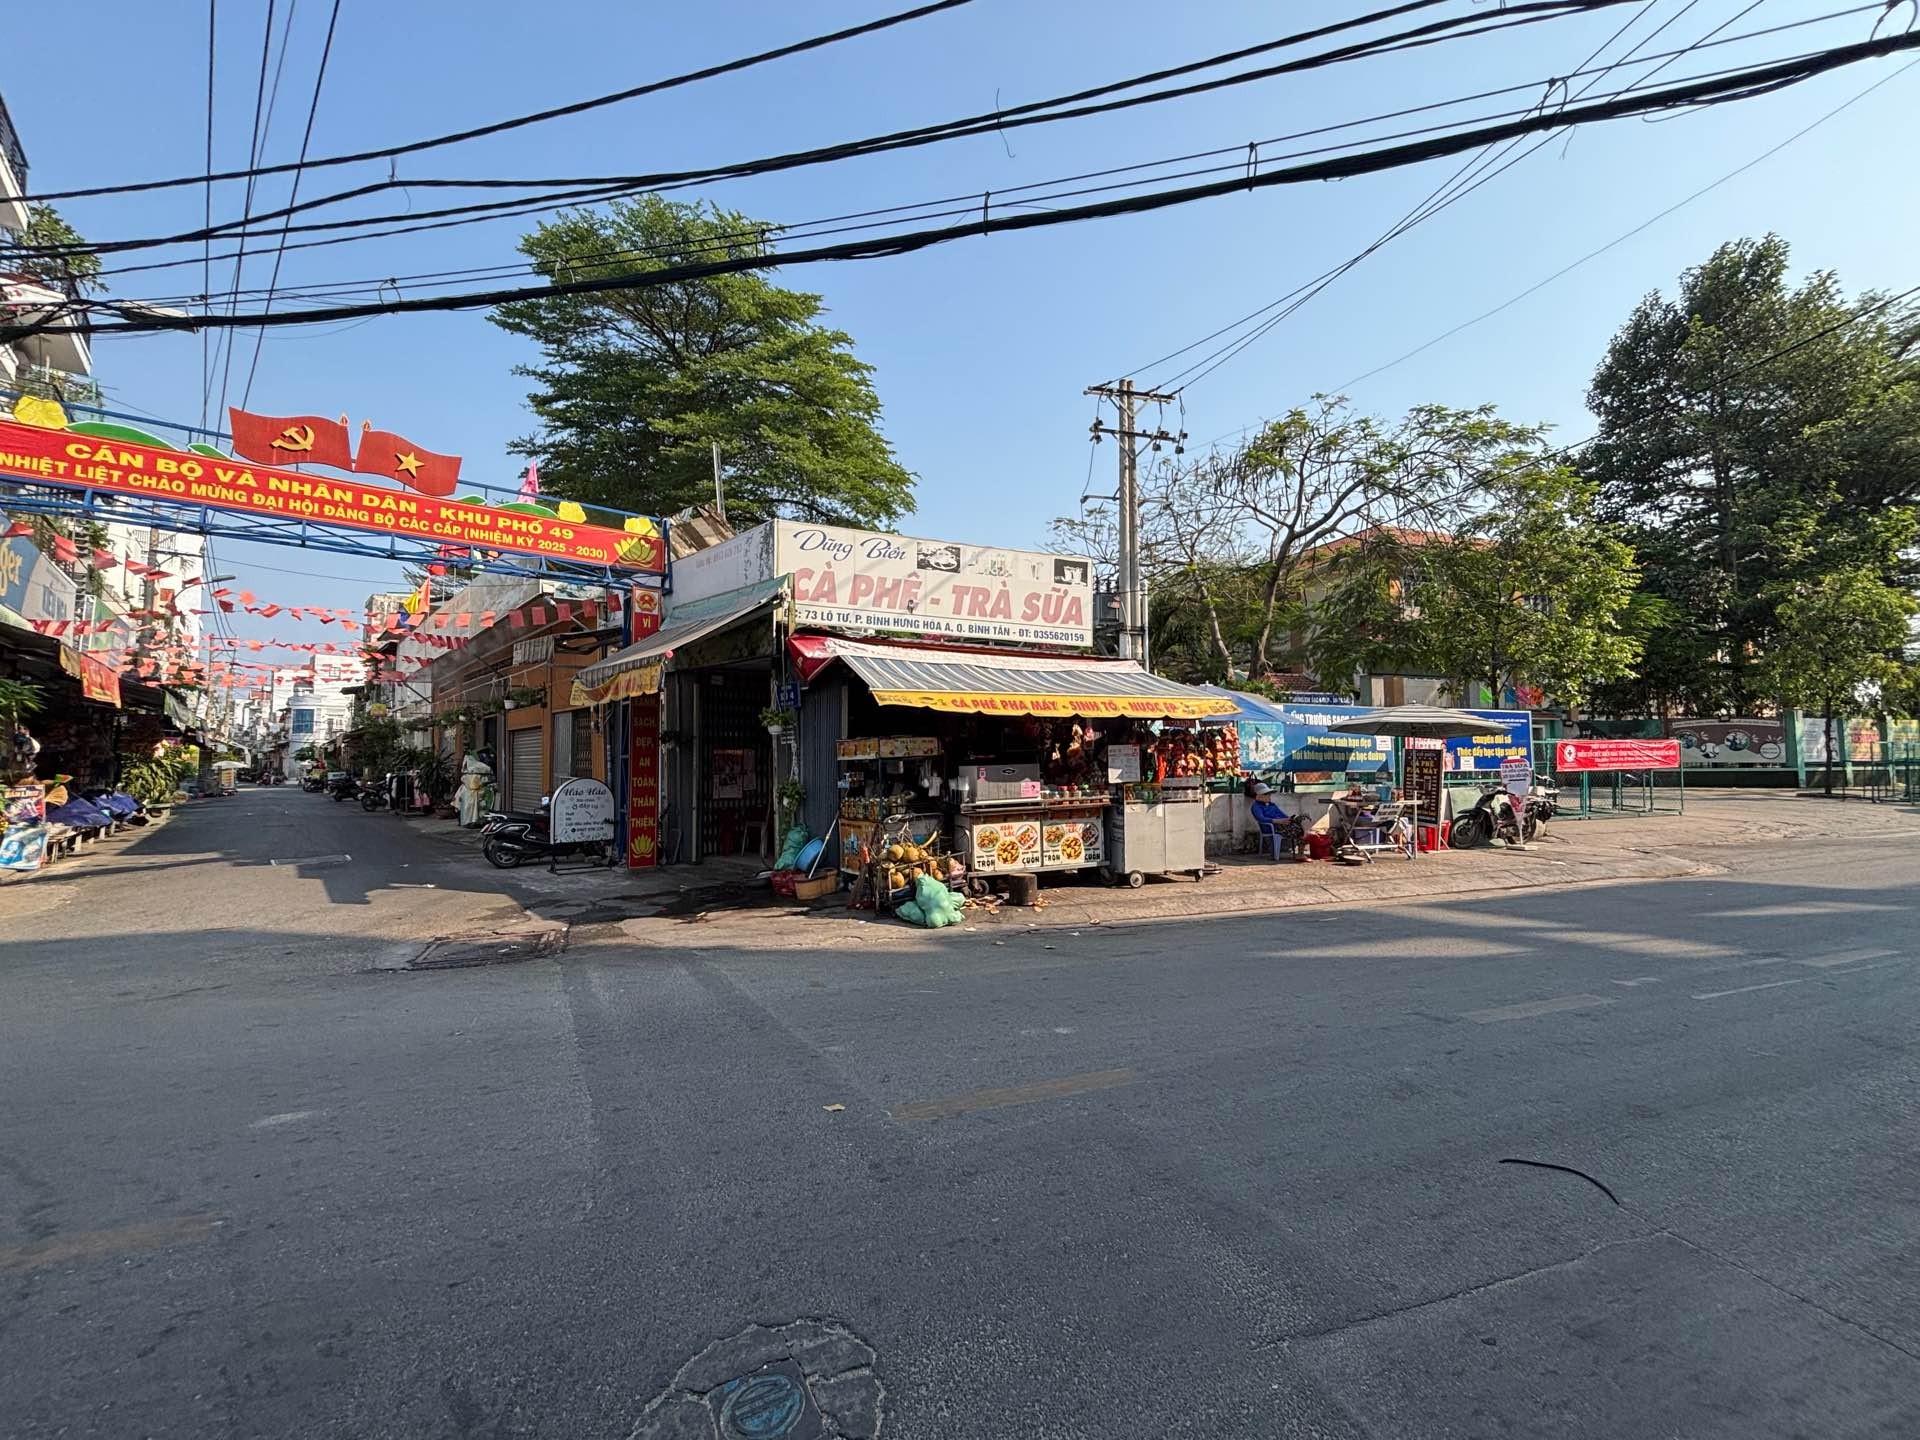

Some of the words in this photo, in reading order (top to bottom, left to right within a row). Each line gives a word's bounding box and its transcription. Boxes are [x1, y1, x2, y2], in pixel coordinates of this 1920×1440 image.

[0, 452, 69, 476] NHIỆT
[74, 464, 123, 484] LIỆT
[128, 473, 185, 492] CHÀO
[191, 483, 248, 502] MỪNG
[252, 493, 284, 510] ĐẠI
[289, 499, 319, 515] HỘI
[323, 503, 369, 521] ĐẢNG
[374, 512, 395, 528] BỘ
[399, 516, 429, 530] CÁC
[433, 521, 462, 535] CẤP
[464, 527, 513, 545] (NHIỆM
[516, 535, 534, 547] KỲ
[538, 539, 566, 552] 2025
[575, 546, 608, 561] 2030)
[65, 443, 144, 468] CÁN
[156, 458, 204, 480] BỘ
[214, 467, 258, 487] VÀ
[268, 477, 353, 503] NHÂN
[362, 494, 417, 514] DÂN
[440, 507, 491, 525] KHU
[497, 517, 543, 534] PHỐ
[549, 527, 574, 540] 49
[793, 529, 853, 561] Dũng
[795, 561, 837, 603] CÀ
[848, 571, 922, 610] PHÊ
[929, 597, 940, 605] -
[951, 580, 1012, 619] TRÀ
[1021, 587, 1083, 625] SỮA
[805, 610, 817, 619] 73
[821, 610, 833, 621] LÔ
[855, 614, 863, 624] P.
[866, 612, 890, 627] BÌNH
[893, 616, 920, 629] HƯNG
[956, 623, 966, 633] Q.
[968, 623, 990, 635] BÌNH
[993, 625, 1010, 636] TÂN
[1018, 628, 1031, 638] ĐT:
[1033, 631, 1084, 641] 0355620159
[1000, 699, 1028, 711] PHA
[1070, 700, 1101, 712] SINH
